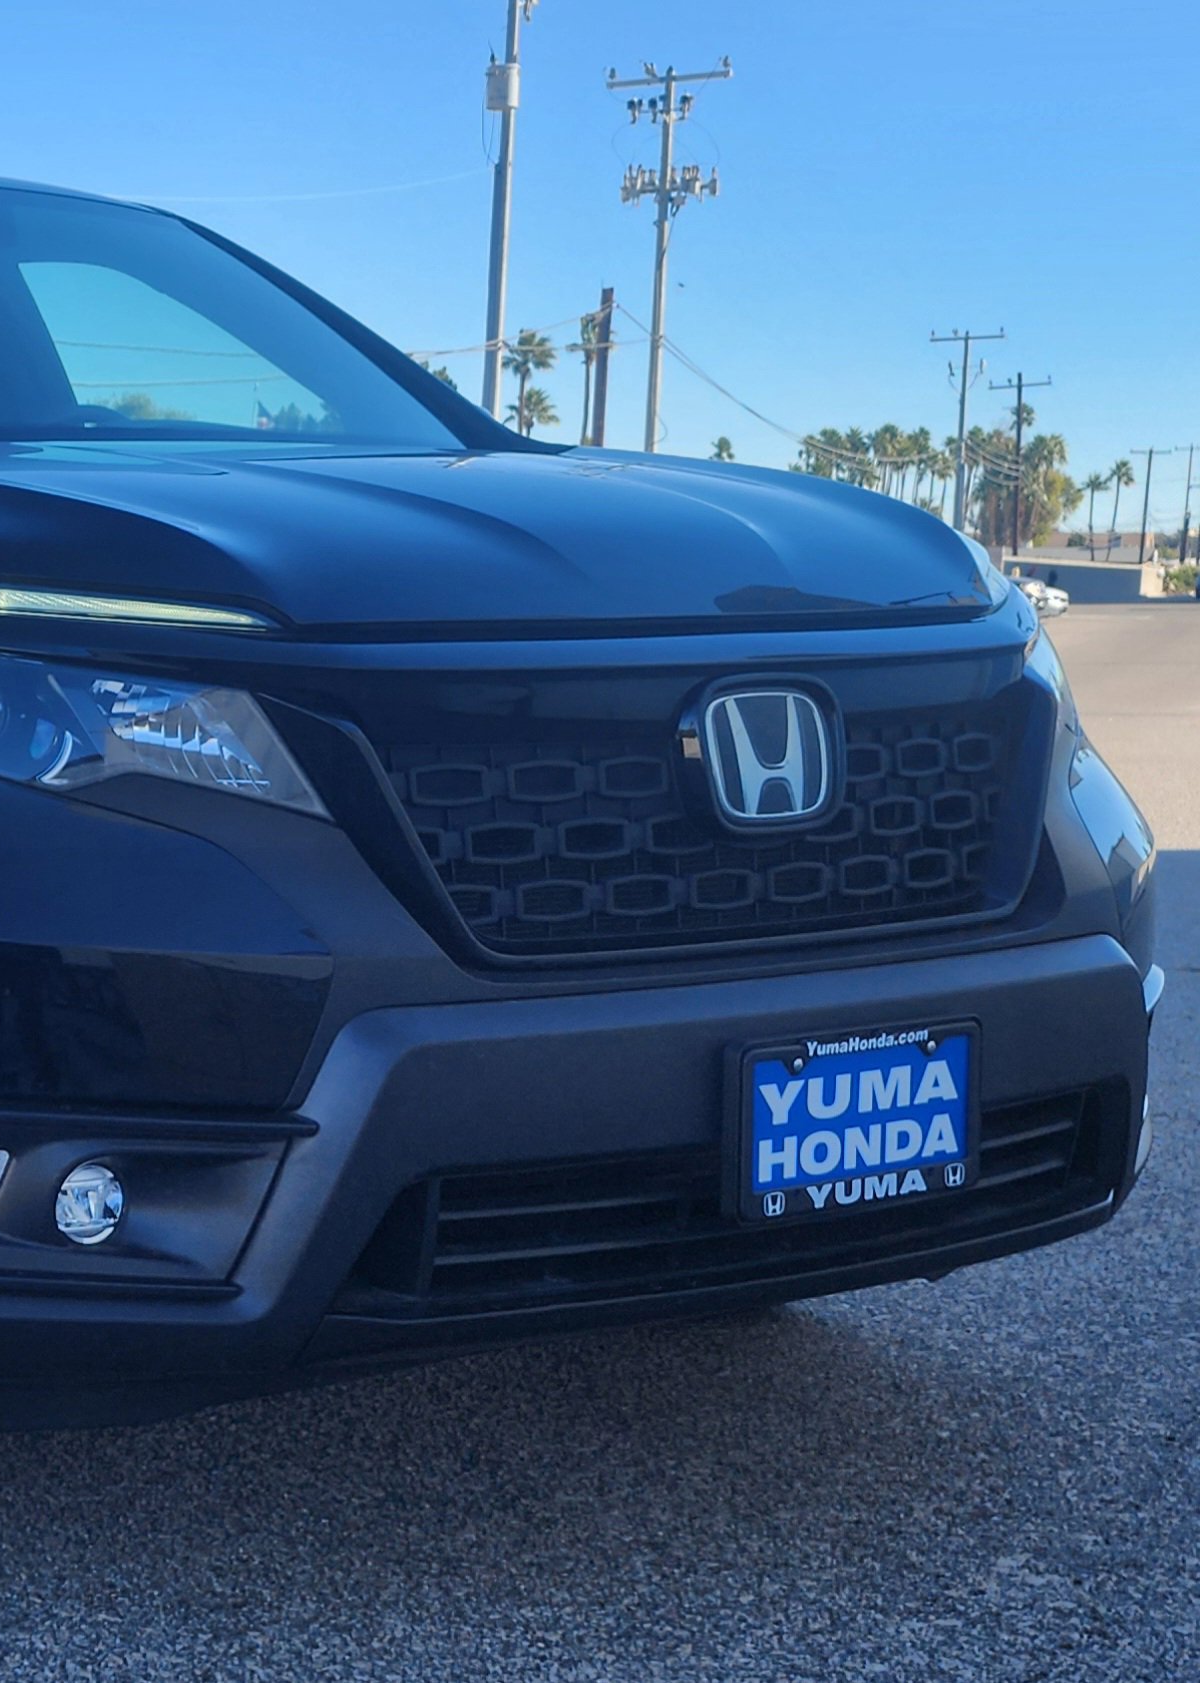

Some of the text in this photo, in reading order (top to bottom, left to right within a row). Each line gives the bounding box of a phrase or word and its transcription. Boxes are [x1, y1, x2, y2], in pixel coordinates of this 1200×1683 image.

[806, 1028, 929, 1057] YumaHonda.com
[758, 1059, 959, 1126] YUMA
[757, 1112, 959, 1184] HONDA
[806, 1169, 928, 1209] YUMA
